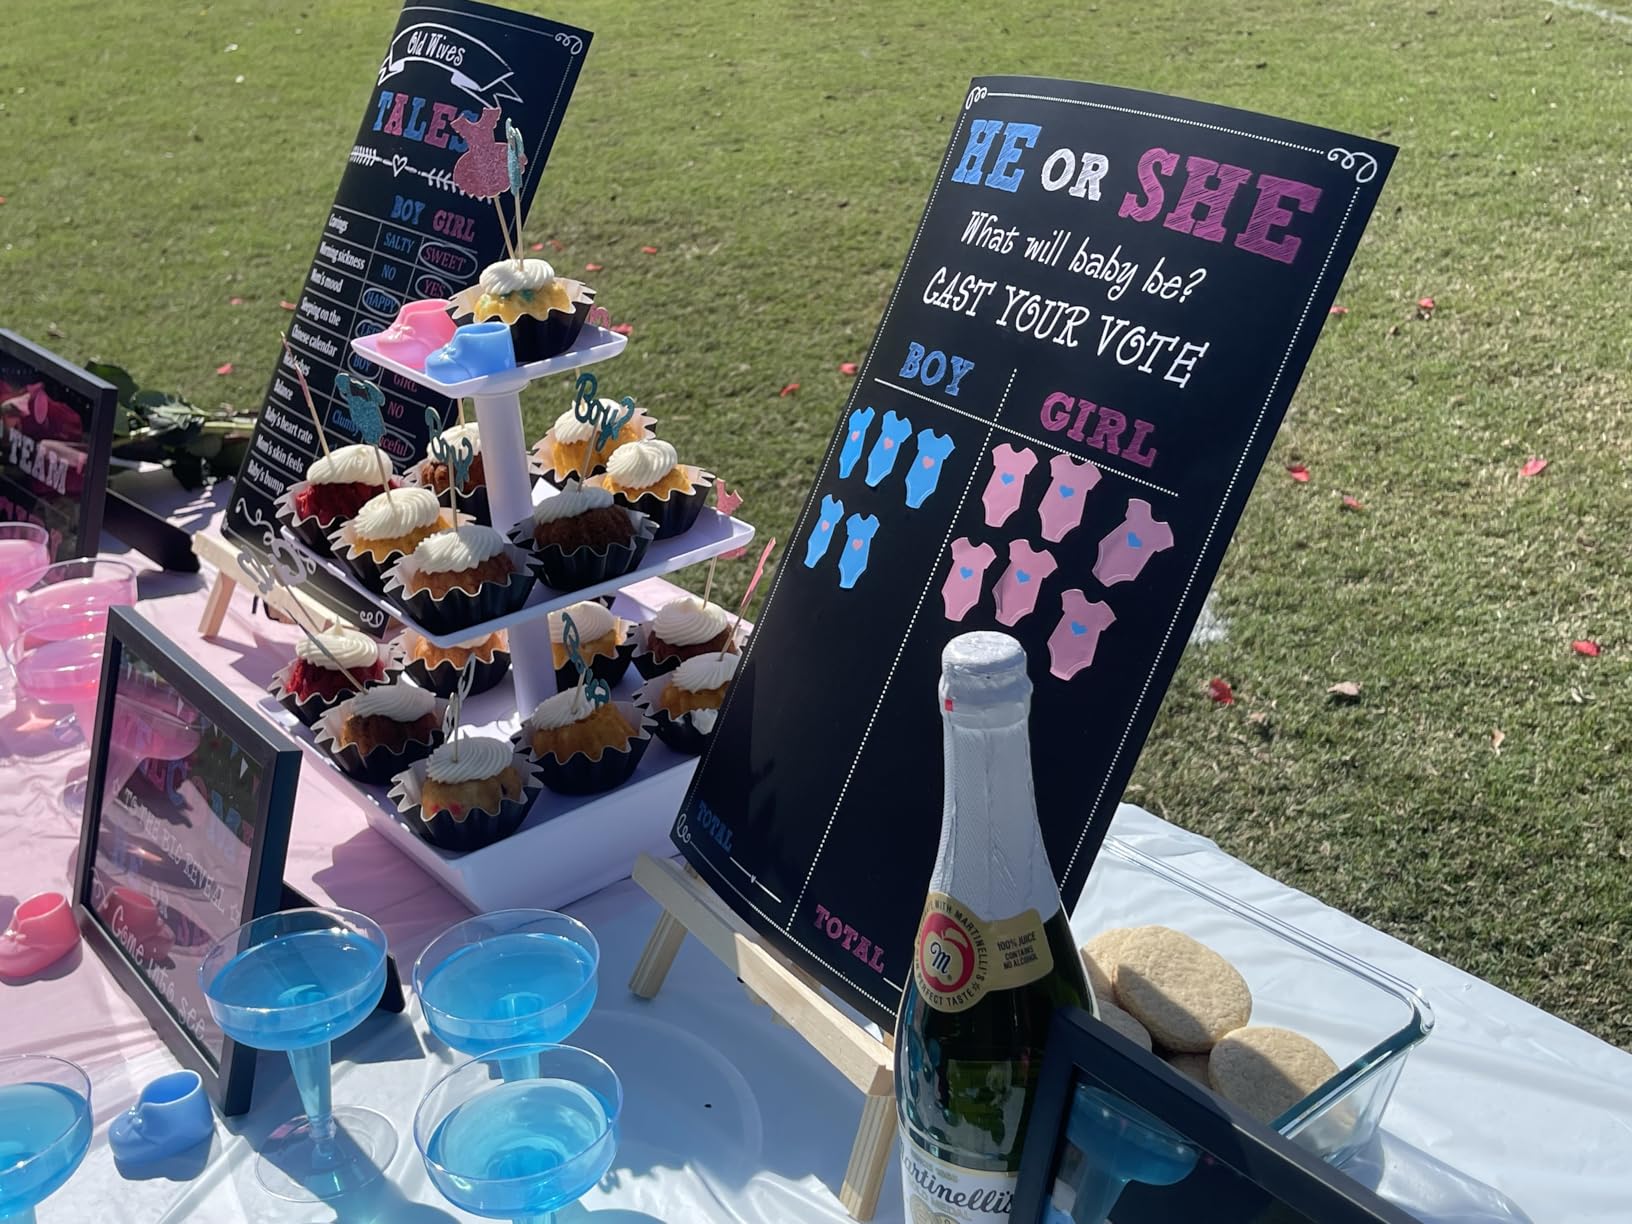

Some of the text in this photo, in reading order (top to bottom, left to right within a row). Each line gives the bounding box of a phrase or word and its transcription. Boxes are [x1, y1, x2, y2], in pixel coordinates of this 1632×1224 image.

[407, 31, 466, 66] Old Wives
[951, 119, 1323, 264] HE OR SHE
[390, 195, 476, 242] BOY GIRL
[337, 246, 366, 270] sickness
[384, 232, 467, 272] SALTY SWEET
[961, 211, 1207, 303] What will baby be?
[323, 276, 344, 293] mood
[381, 264, 446, 298] NO YES
[319, 311, 330, 324] on
[328, 310, 341, 327] the
[366, 290, 397, 313] HAPPY
[308, 334, 338, 357] calendar
[923, 266, 1210, 389] CAST YOUR VOTE
[899, 341, 975, 397] BOY
[387, 401, 405, 418] NO
[279, 415, 299, 437] heart
[298, 427, 313, 445] rate
[1040, 390, 1158, 468] GIRL
[8, 427, 69, 495] TEAM
[271, 444, 287, 462] skin
[285, 451, 304, 474] feels
[263, 469, 285, 495] bump
[696, 800, 734, 853] TOTAL
[183, 852, 225, 913] REVEAL
[111, 904, 145, 966] Come
[815, 904, 885, 974] TOTAL
[954, 909, 989, 982] MARTINELLI'S
[1018, 931, 1037, 948] JUICE
[946, 989, 975, 1007] TASTE
